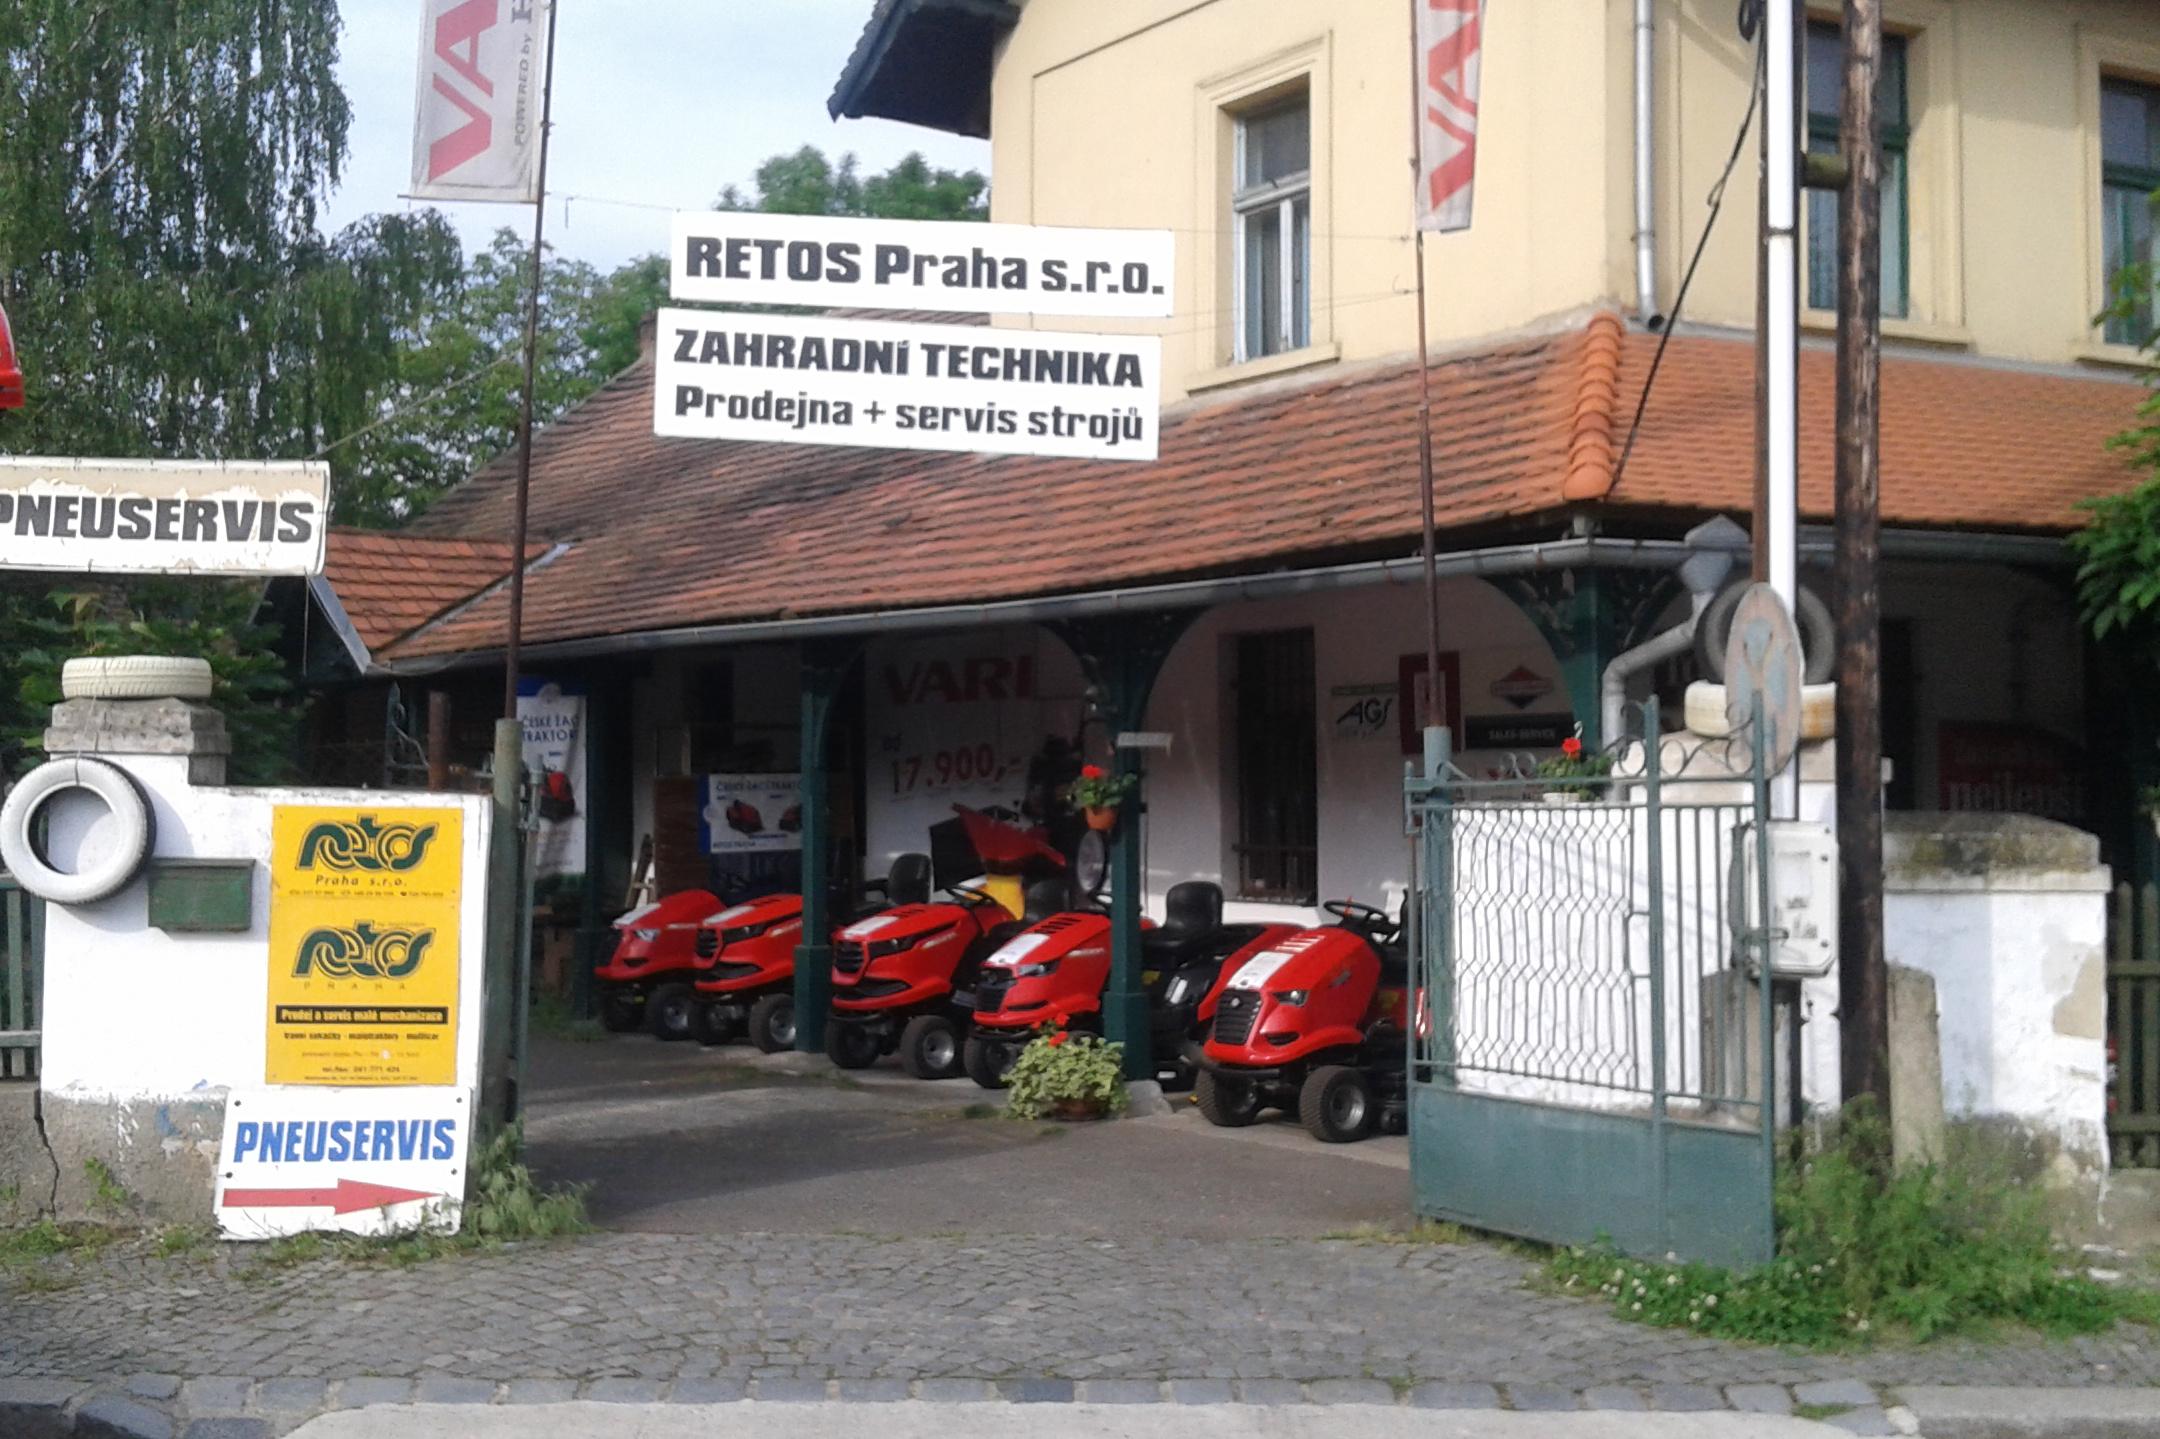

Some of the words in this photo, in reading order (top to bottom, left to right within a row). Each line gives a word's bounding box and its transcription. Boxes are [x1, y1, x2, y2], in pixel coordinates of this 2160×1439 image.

[685, 234, 862, 284] RETOS
[874, 243, 1028, 291] Praha
[1040, 257, 1165, 297] s.r.o.
[673, 327, 910, 376] ZAHRADNÍ
[919, 342, 1144, 388] TECHNIKA
[674, 383, 853, 430] Prodejna
[862, 399, 887, 424] +
[895, 400, 1018, 435] servis
[1027, 406, 1144, 446] strojů
[885, 656, 1033, 706] VARI
[315, 874, 359, 886] Praha
[369, 876, 407, 887] s.r.o.
[233, 1118, 456, 1163] PNEUSERVIS
